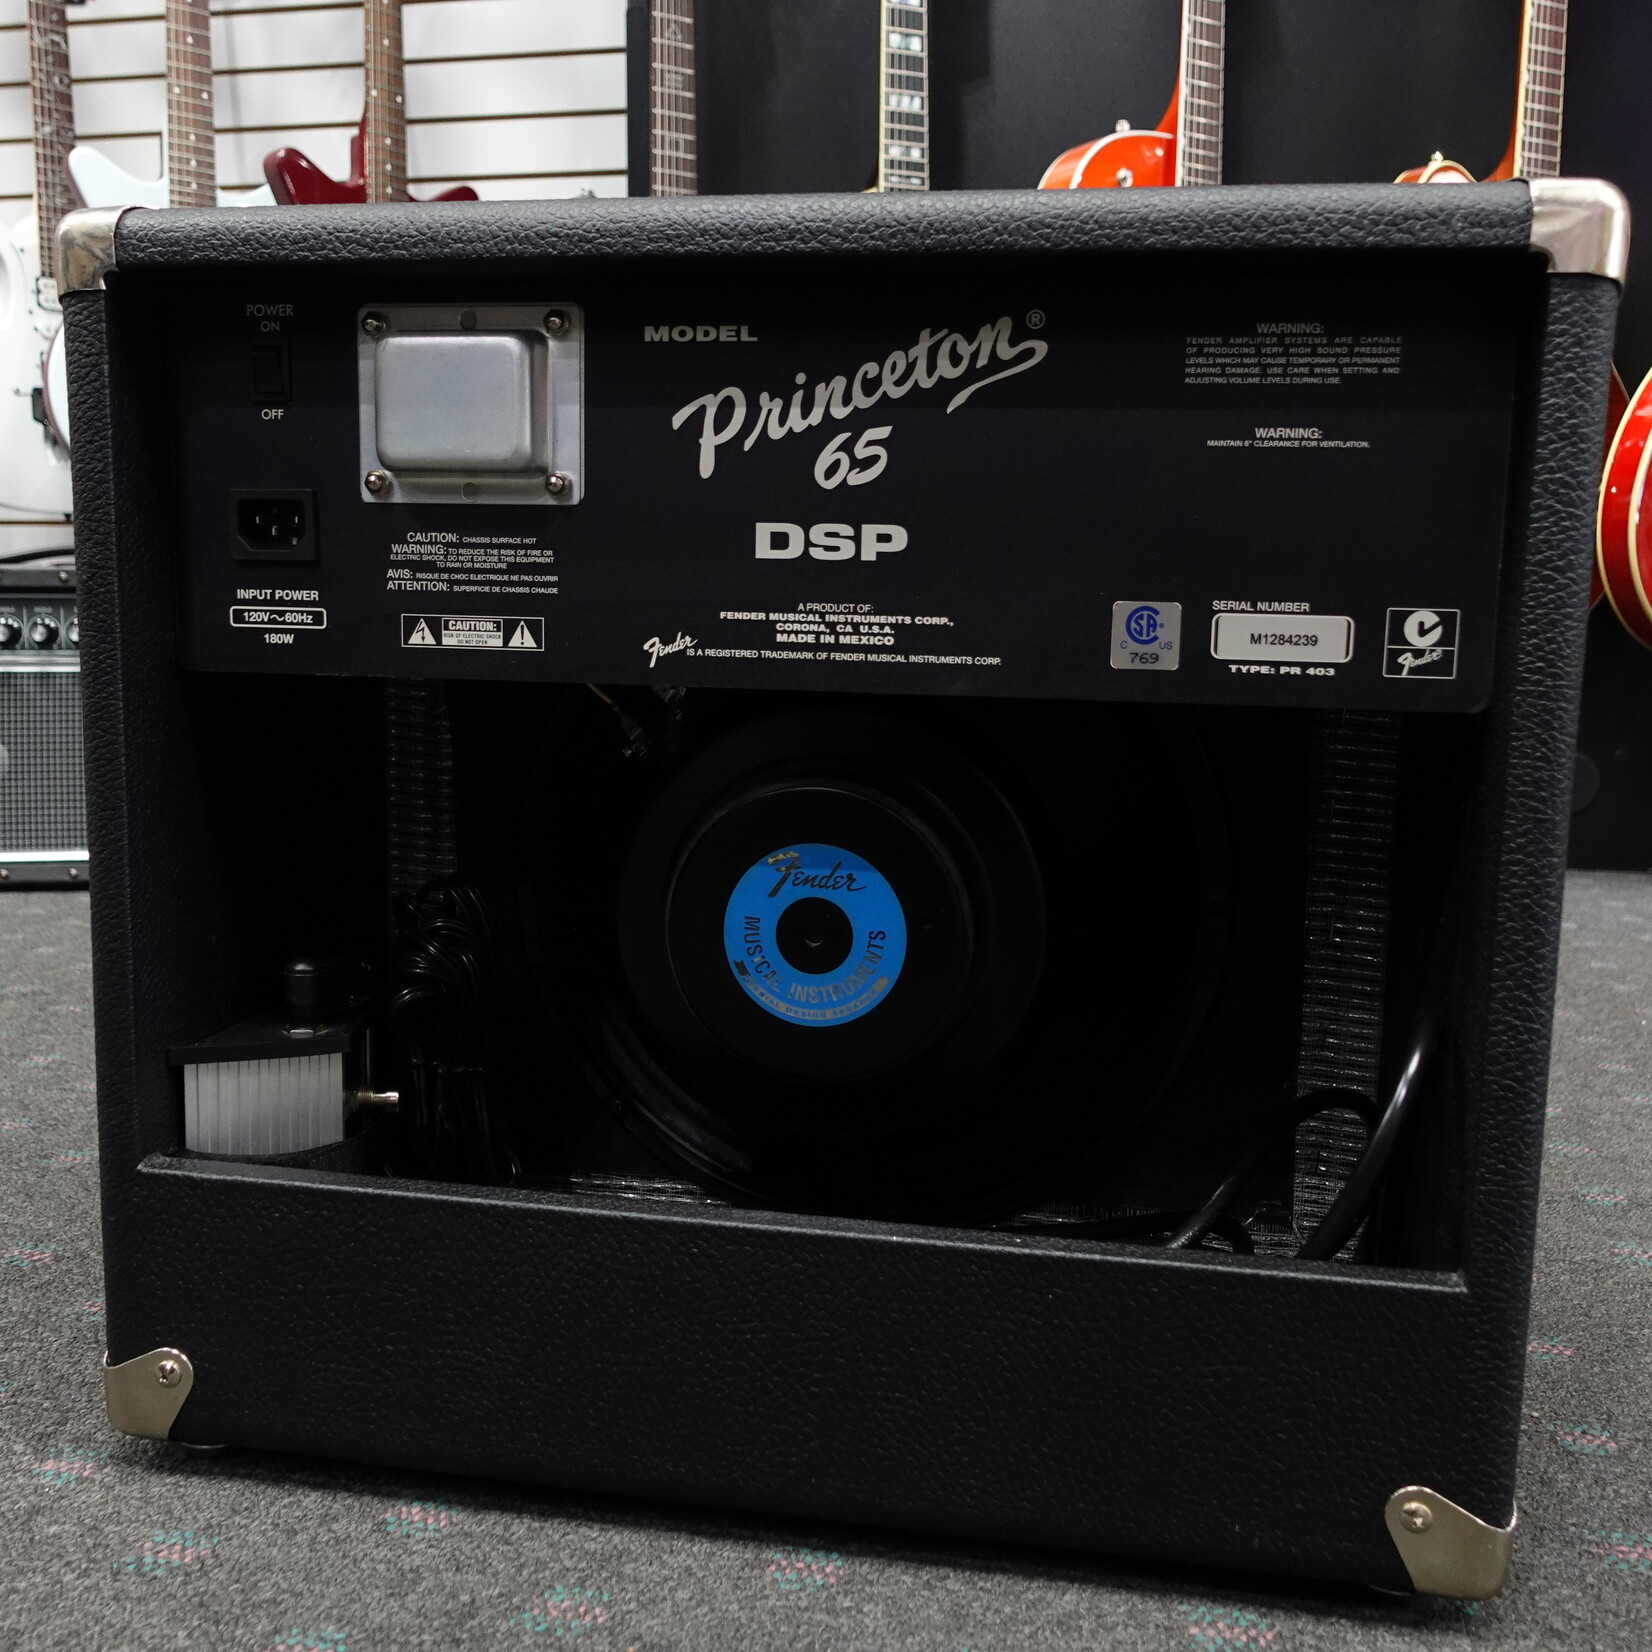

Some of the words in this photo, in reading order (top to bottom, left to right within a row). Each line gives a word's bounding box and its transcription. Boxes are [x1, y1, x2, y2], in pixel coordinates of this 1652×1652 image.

[246, 304, 294, 316] POWER
[260, 321, 280, 332] ON
[1256, 323, 1324, 334] WARNING:
[644, 325, 758, 342] MODEL
[672, 316, 1048, 480] Princeton
[261, 409, 284, 420] OFF
[1255, 428, 1323, 439] WARNING:
[814, 426, 893, 490] 65
[407, 532, 460, 543] CAUTION:
[755, 522, 908, 562] DSP
[392, 544, 446, 554] WARNING:
[386, 569, 413, 578] AVIS:
[386, 581, 450, 591] ATTENTION:
[237, 589, 272, 600] INPUT
[275, 590, 318, 600] POWER
[798, 604, 804, 612] A
[806, 604, 854, 613] PRODUCT
[856, 604, 874, 613] OF:
[1212, 601, 1254, 612] SERIAL
[1257, 602, 1310, 612] NUMBER
[720, 612, 766, 622] FENDER
[770, 613, 822, 622] MUSICAL
[825, 614, 912, 624] INSTRUMENTS
[914, 616, 954, 626] CORP.,
[448, 620, 498, 632] CAUTION:
[776, 623, 830, 634] CORONA,
[836, 624, 852, 632] CA
[860, 624, 894, 634] U.S.A.
[264, 634, 294, 644] 180W
[776, 634, 816, 644] MADE
[820, 634, 835, 644] IN
[839, 634, 894, 645] MEXICO
[1250, 633, 1318, 647] M1284239
[644, 632, 698, 668] Fender
[1159, 641, 1172, 650] US
[696, 648, 704, 656] A
[705, 650, 758, 658] REGISTERED
[760, 651, 814, 660] TRADEMARK
[816, 652, 828, 660] OF
[830, 652, 865, 661] FENDER
[868, 654, 907, 662] MUSICAL
[909, 655, 972, 664] INSTRUMENTS
[974, 656, 1001, 666] CORP.
[1130, 652, 1159, 664] 769
[1229, 665, 1276, 675] TYPE:
[1280, 666, 1302, 676] PR
[1304, 666, 1336, 676] 403
[768, 851, 867, 898] Fender
[744, 916, 781, 992] MUSICAL
[788, 930, 886, 1004] INSTRUMENTS
